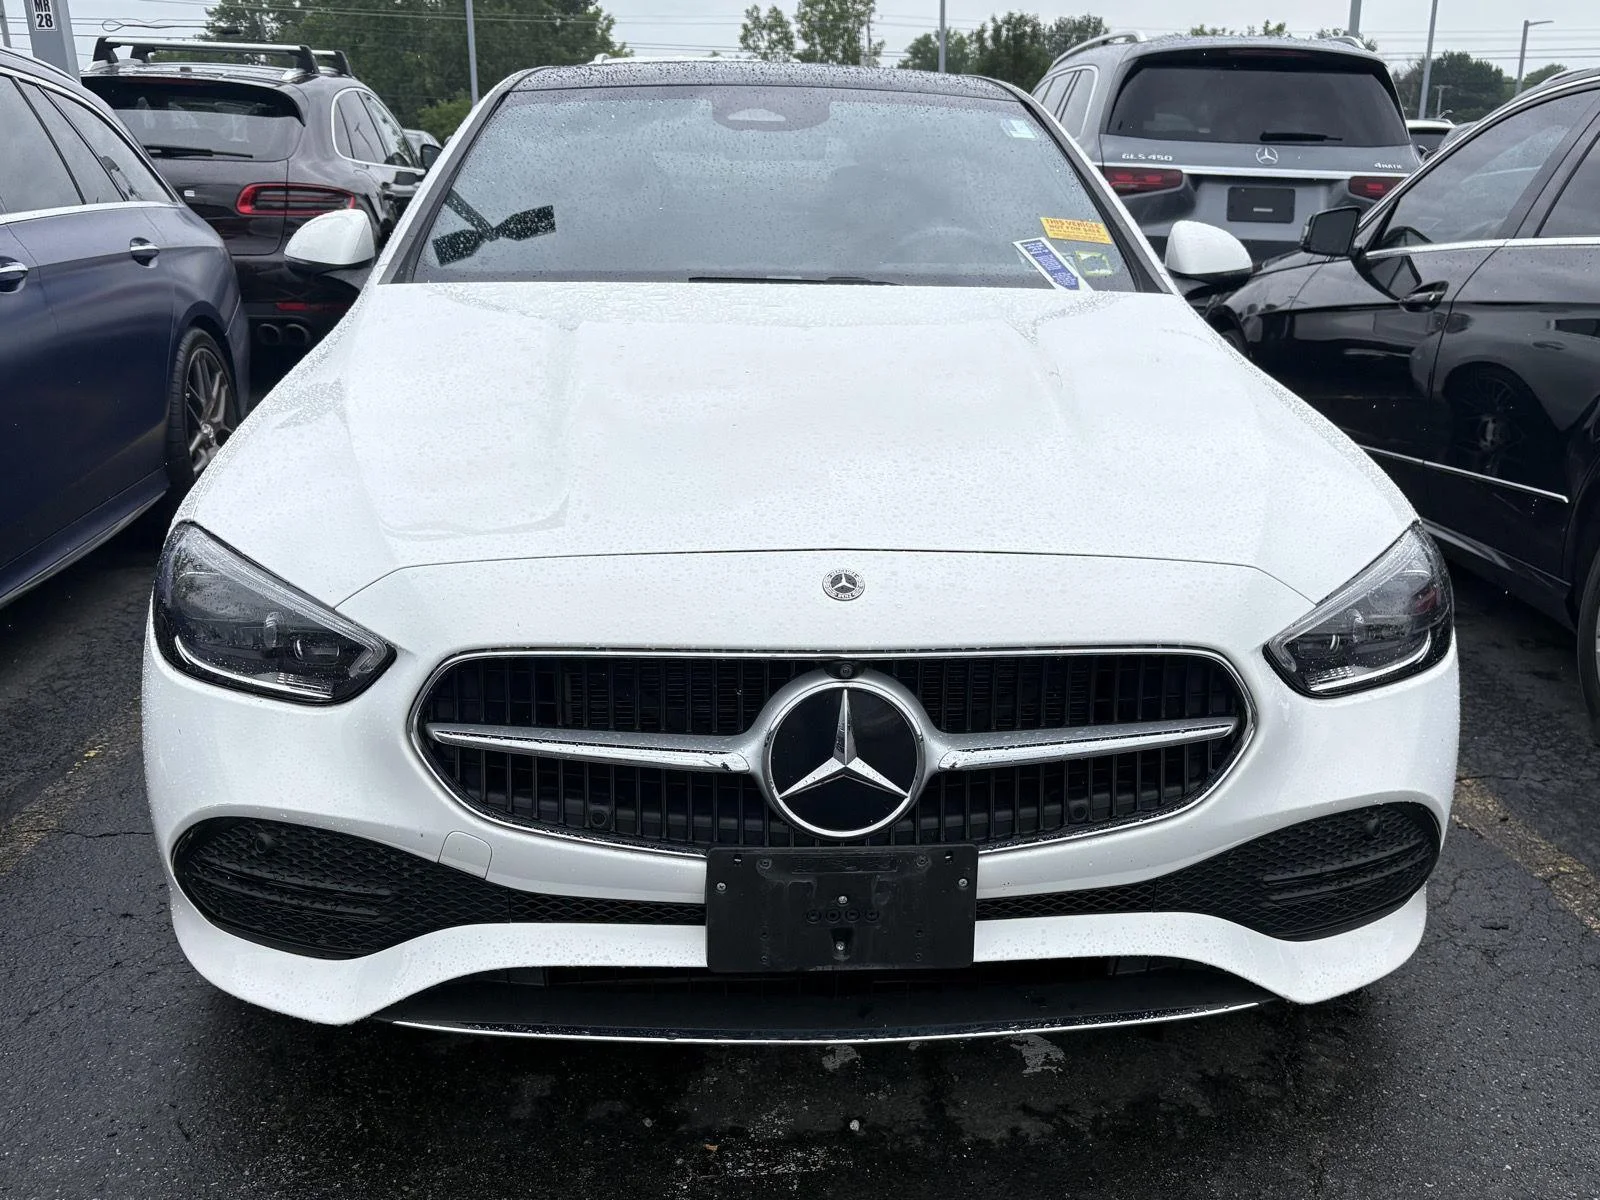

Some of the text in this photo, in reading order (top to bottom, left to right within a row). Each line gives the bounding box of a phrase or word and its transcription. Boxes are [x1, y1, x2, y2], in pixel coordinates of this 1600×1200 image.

[34, 0, 51, 12] MR
[37, 13, 53, 28] 28
[1147, 154, 1173, 162] 450
